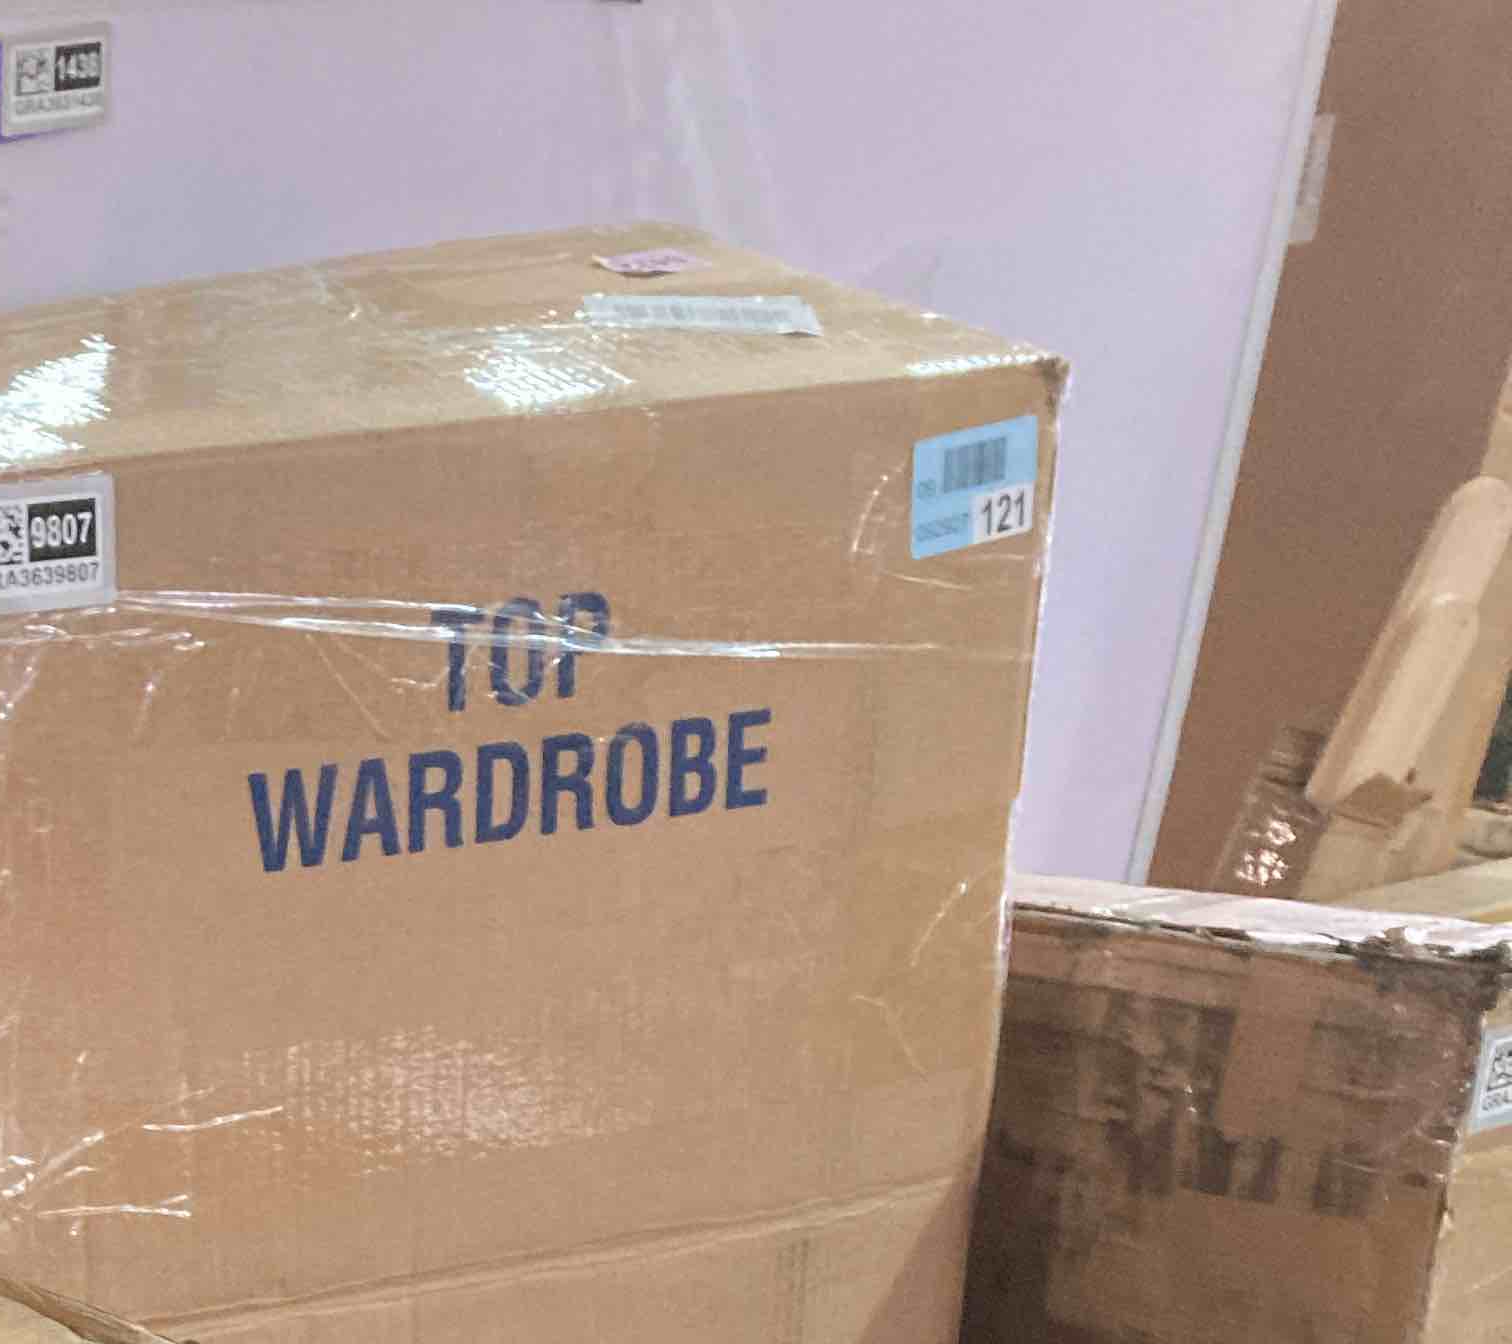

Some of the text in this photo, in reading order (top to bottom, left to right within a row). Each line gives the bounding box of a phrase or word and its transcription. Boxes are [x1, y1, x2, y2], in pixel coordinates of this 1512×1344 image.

[29, 511, 94, 550] 9807
[981, 489, 1026, 537] 121
[430, 591, 612, 713] TOP
[247, 708, 772, 873] WARDROBE
